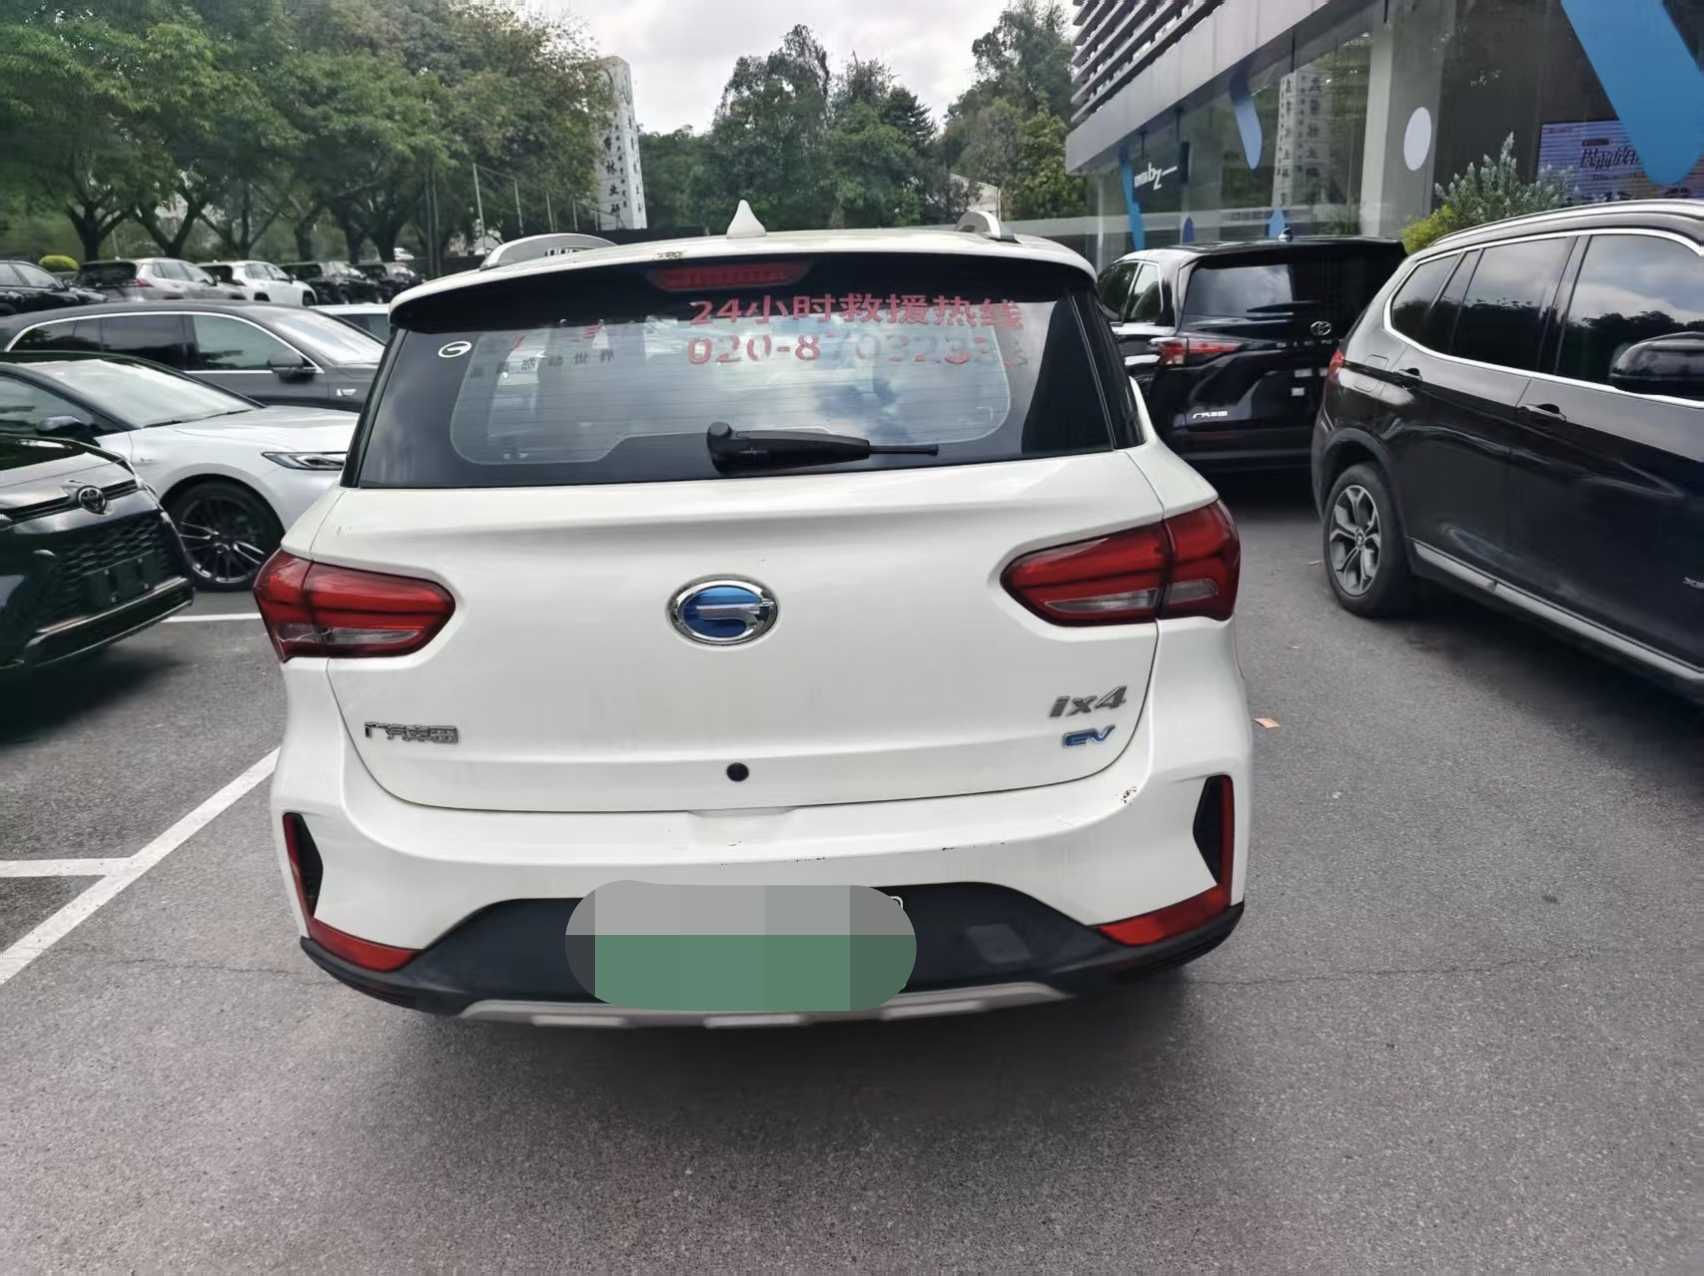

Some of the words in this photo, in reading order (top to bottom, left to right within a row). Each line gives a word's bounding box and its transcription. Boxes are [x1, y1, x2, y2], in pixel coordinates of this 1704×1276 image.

[689, 292, 1024, 330] 24小时救援热线
